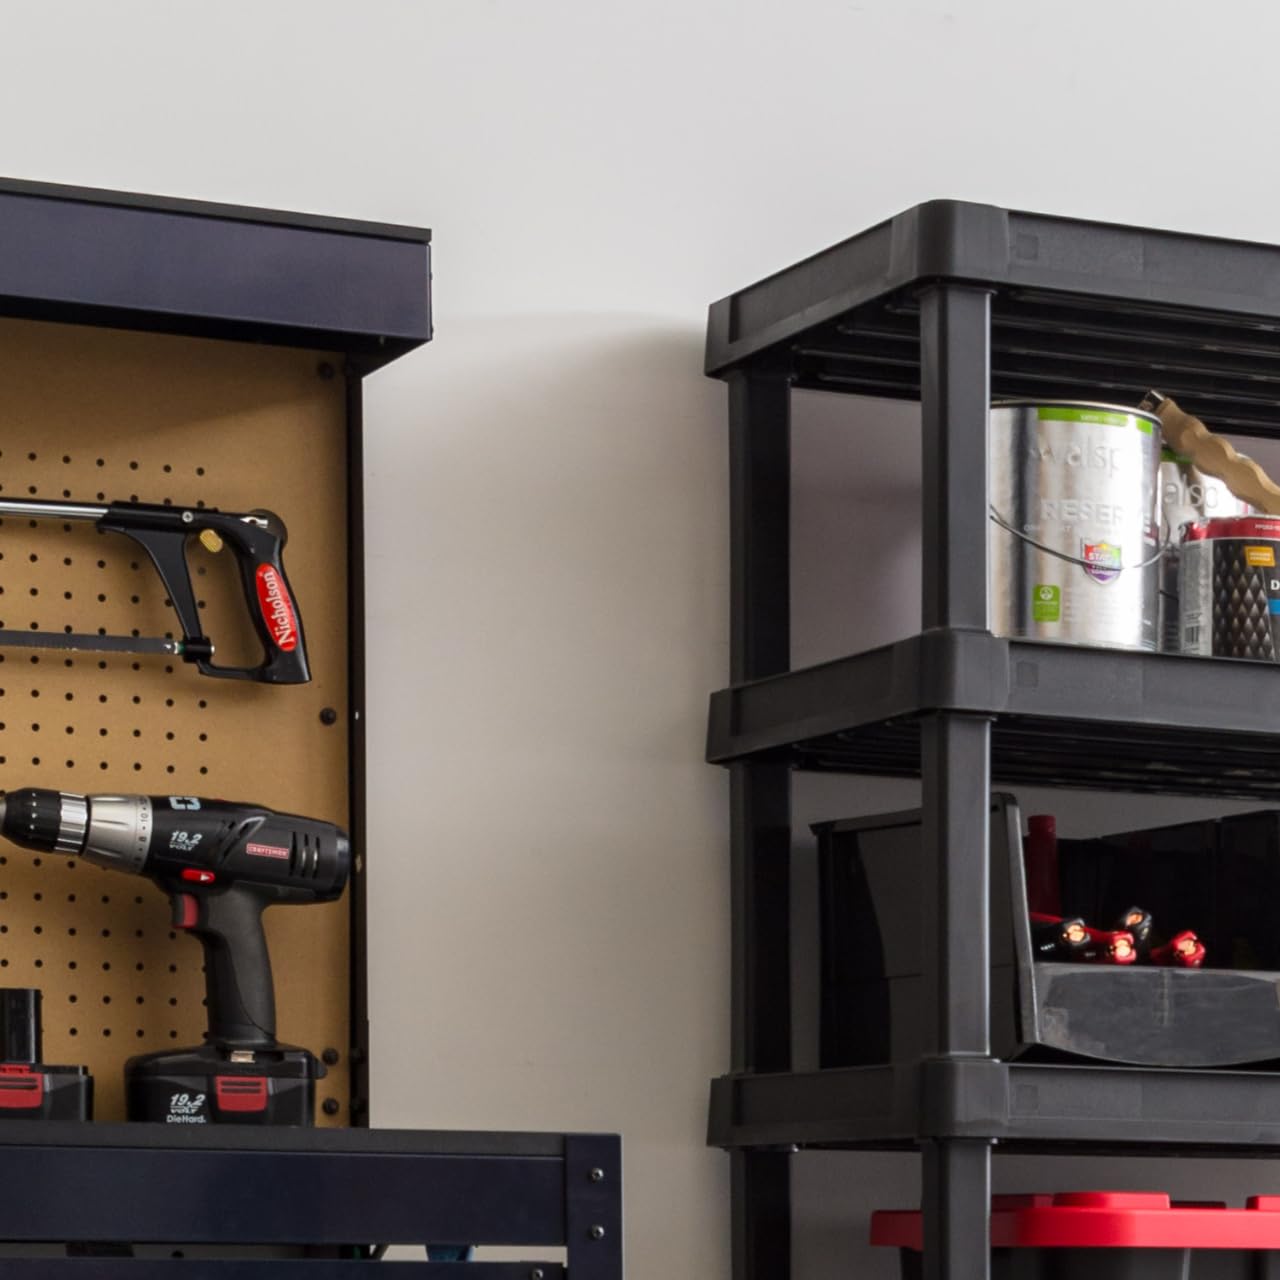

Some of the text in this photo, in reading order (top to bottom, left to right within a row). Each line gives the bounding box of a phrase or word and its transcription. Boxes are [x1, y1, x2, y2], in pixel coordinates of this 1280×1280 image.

[263, 571, 295, 646] Nicholson
[170, 830, 202, 844] 19.2
[170, 1094, 205, 1106] 19.2
